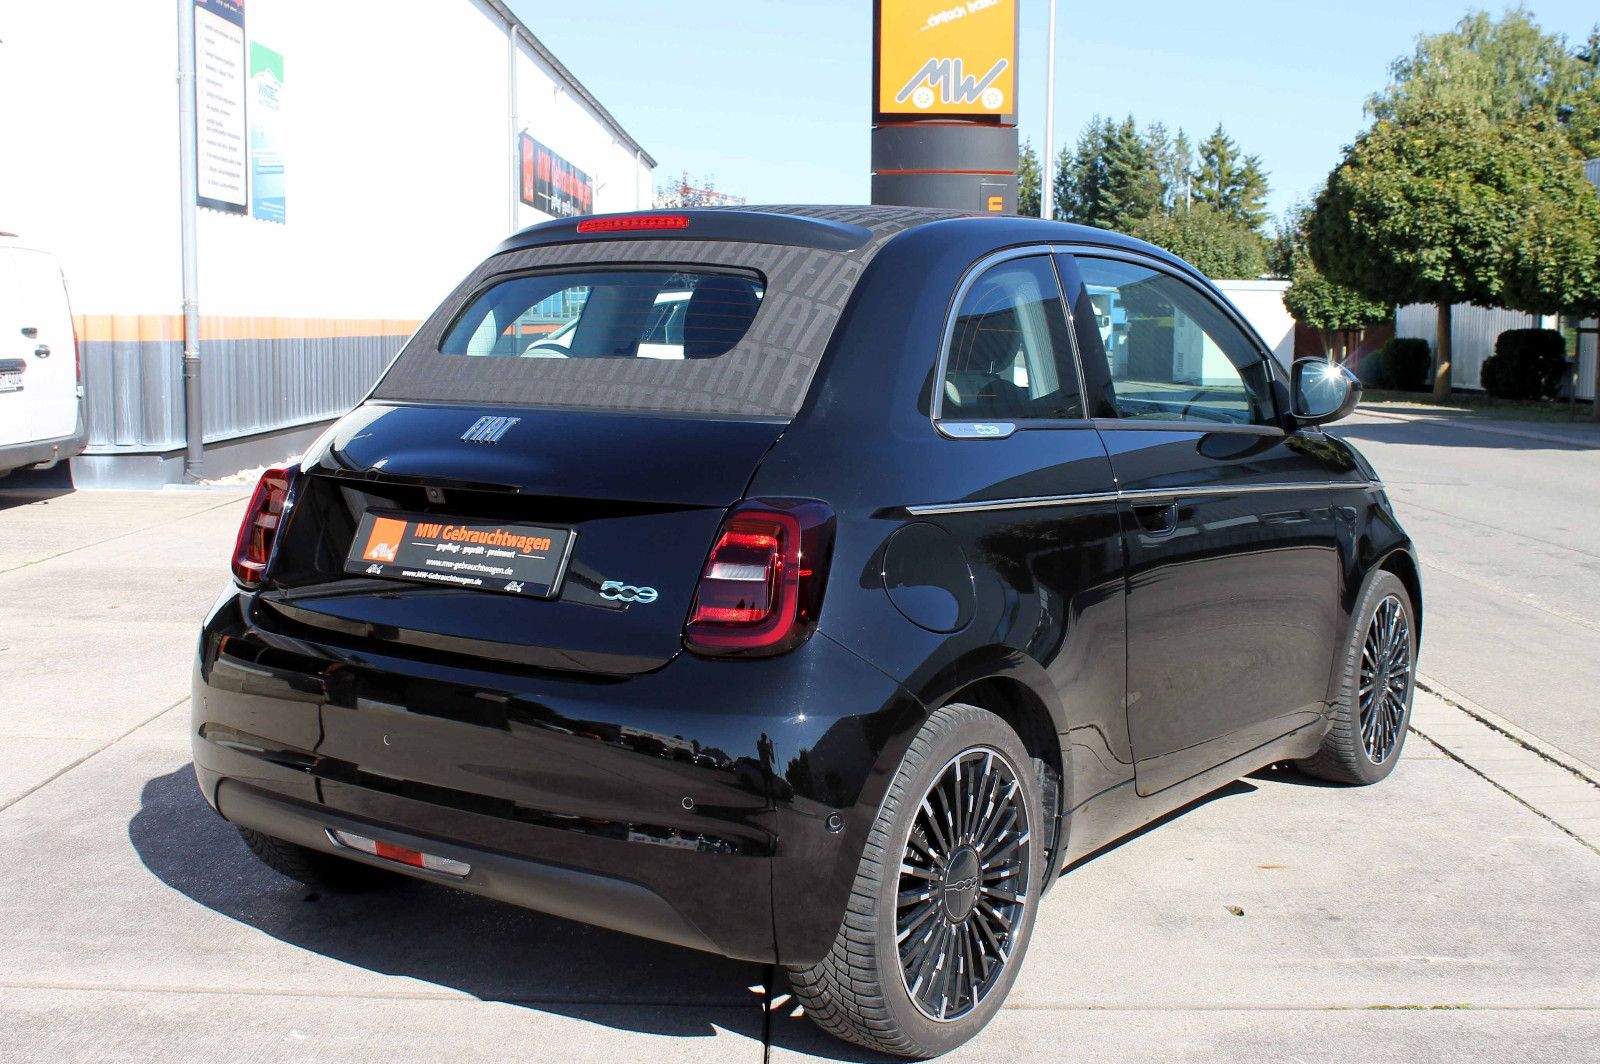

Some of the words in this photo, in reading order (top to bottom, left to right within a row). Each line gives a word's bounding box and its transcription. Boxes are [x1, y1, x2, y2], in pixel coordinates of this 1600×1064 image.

[896, 58, 1008, 104] MW
[460, 416, 521, 443] FIAT
[414, 522, 442, 538] MW
[442, 525, 551, 553] Gebrauchtwagen
[599, 580, 658, 604] 500
